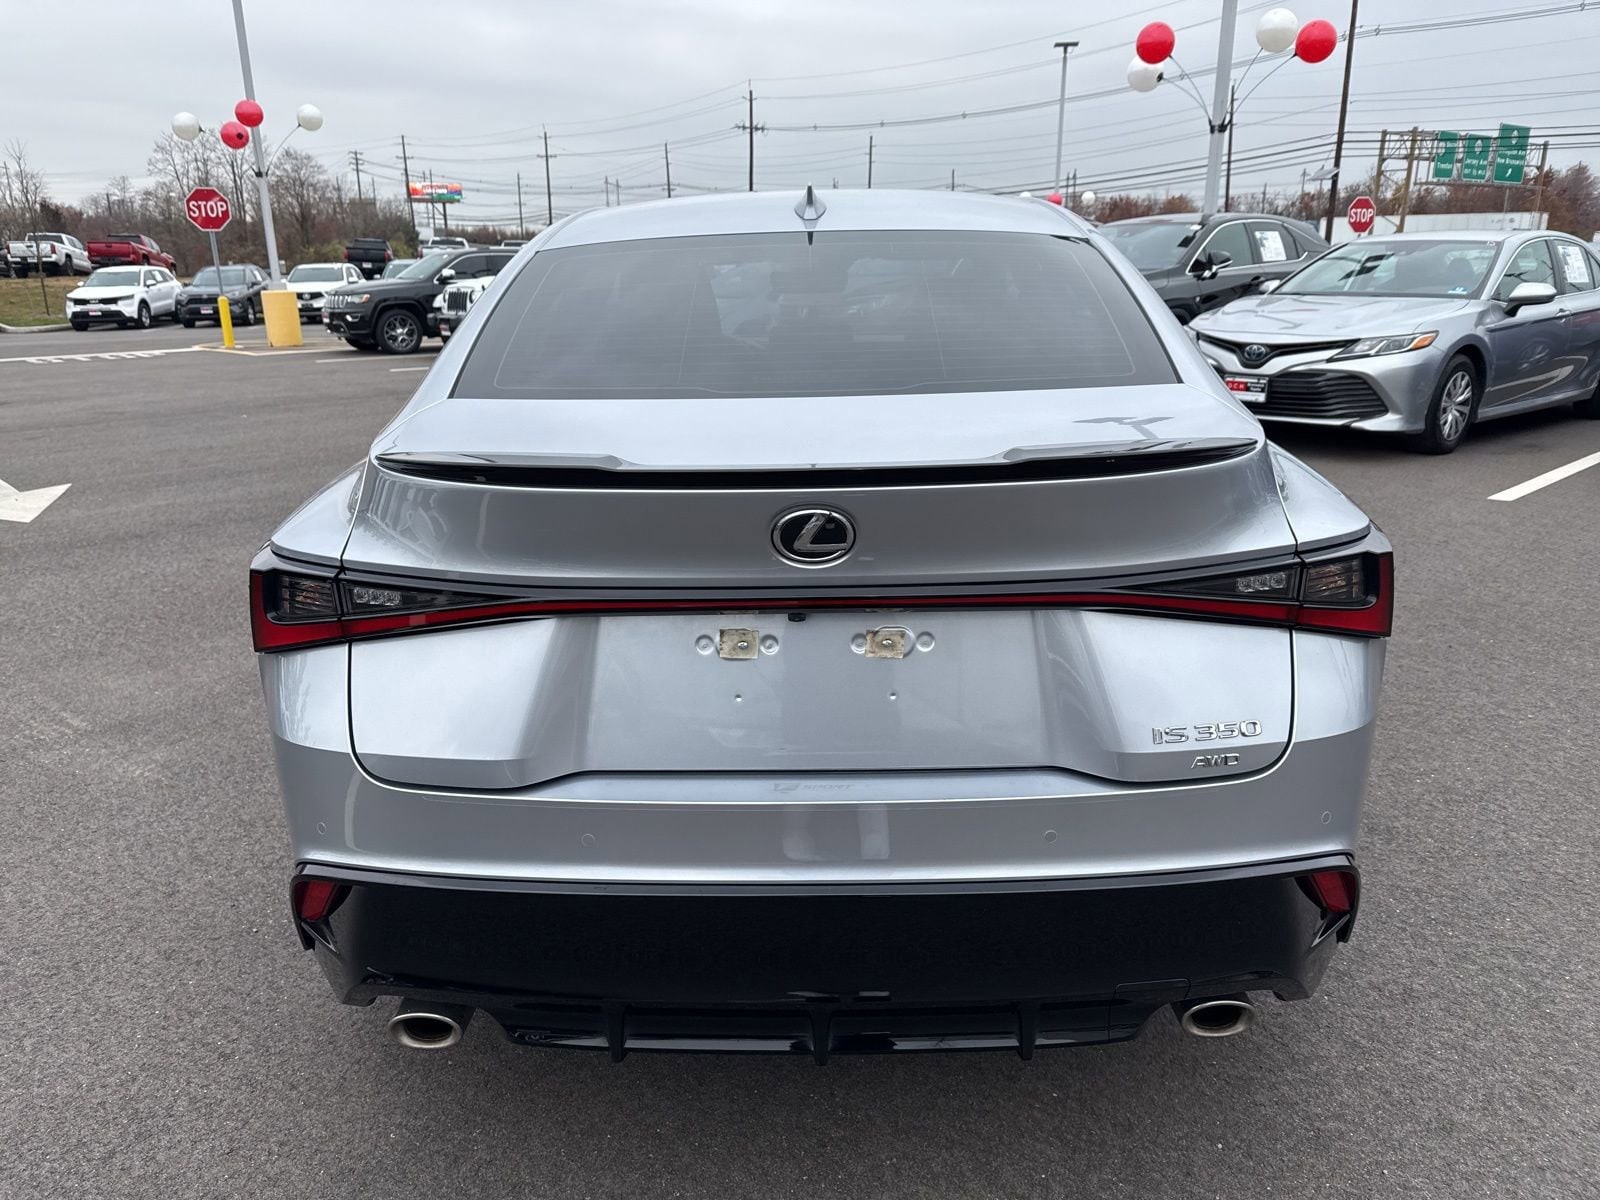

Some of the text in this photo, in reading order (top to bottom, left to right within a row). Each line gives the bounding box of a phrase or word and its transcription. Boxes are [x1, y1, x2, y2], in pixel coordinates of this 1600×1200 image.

[189, 200, 227, 218] STOP
[1350, 208, 1374, 223] STOP
[1152, 720, 1262, 744] IS 350
[1190, 753, 1240, 769] AWD
